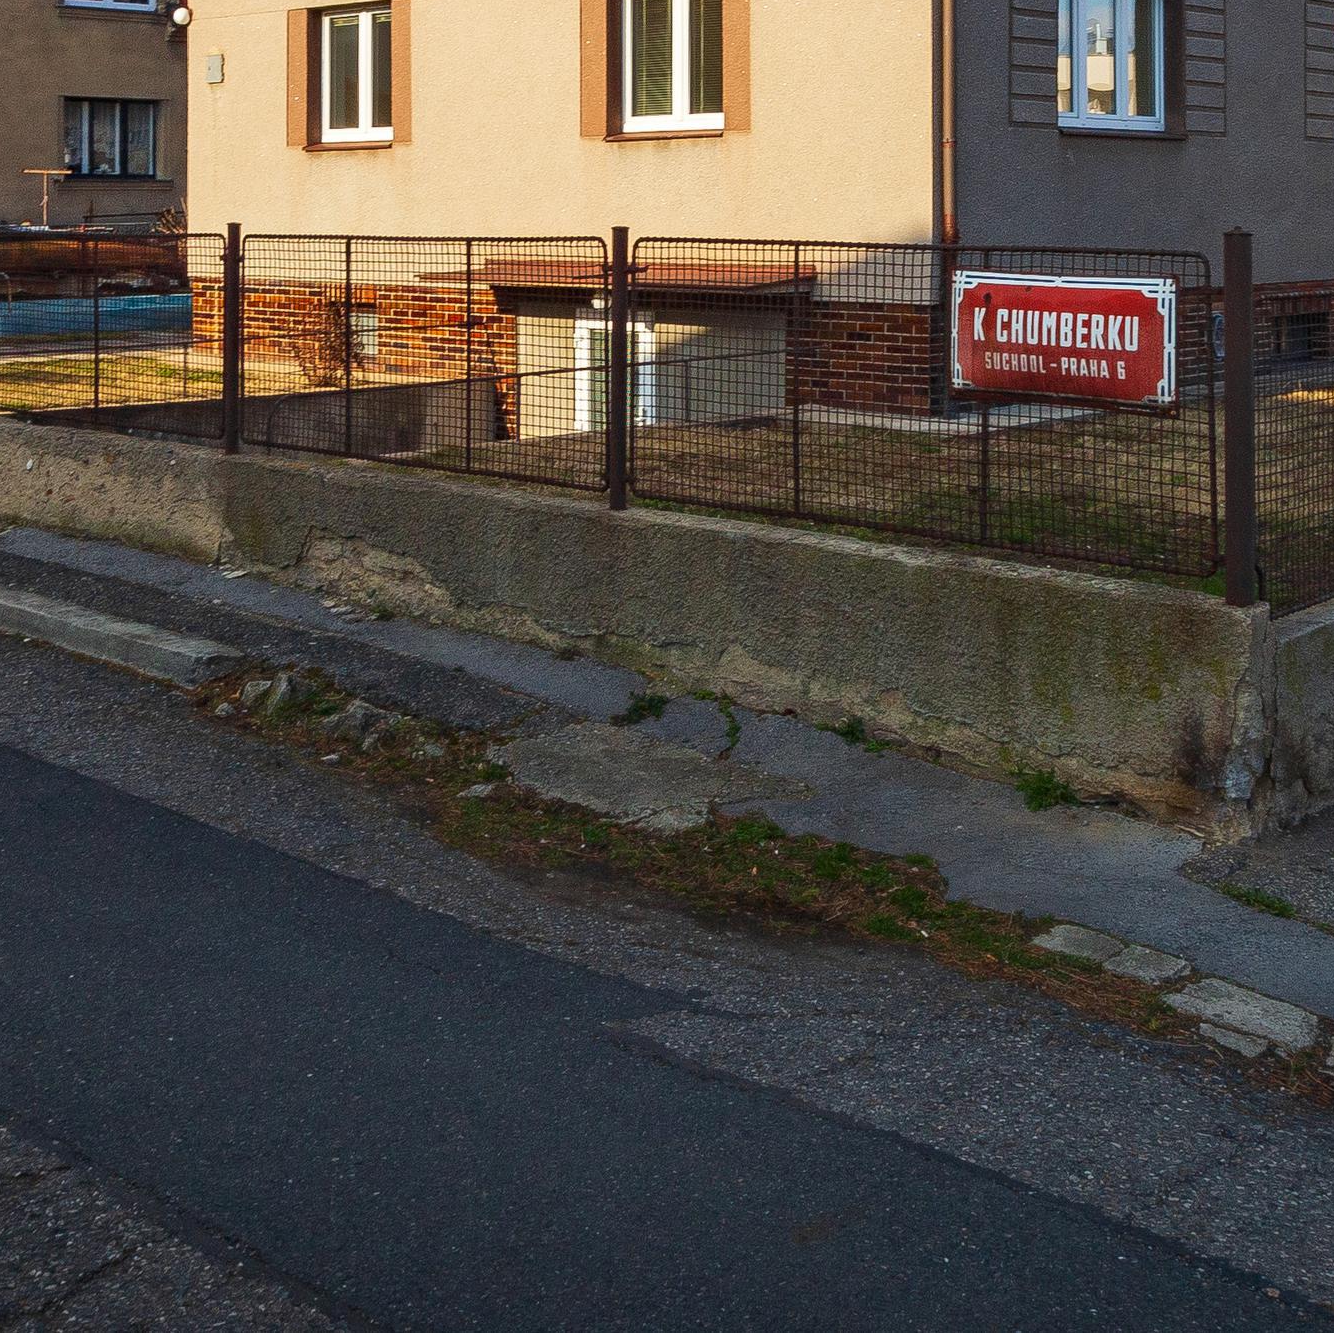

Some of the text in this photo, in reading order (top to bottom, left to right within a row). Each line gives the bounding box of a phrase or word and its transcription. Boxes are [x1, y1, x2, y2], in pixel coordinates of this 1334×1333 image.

[973, 307, 1139, 352] K CHUMBERKU
[984, 351, 1047, 374] SUCHDOL
[1061, 356, 1110, 379] PRAHA
[1117, 360, 1127, 379] 6
